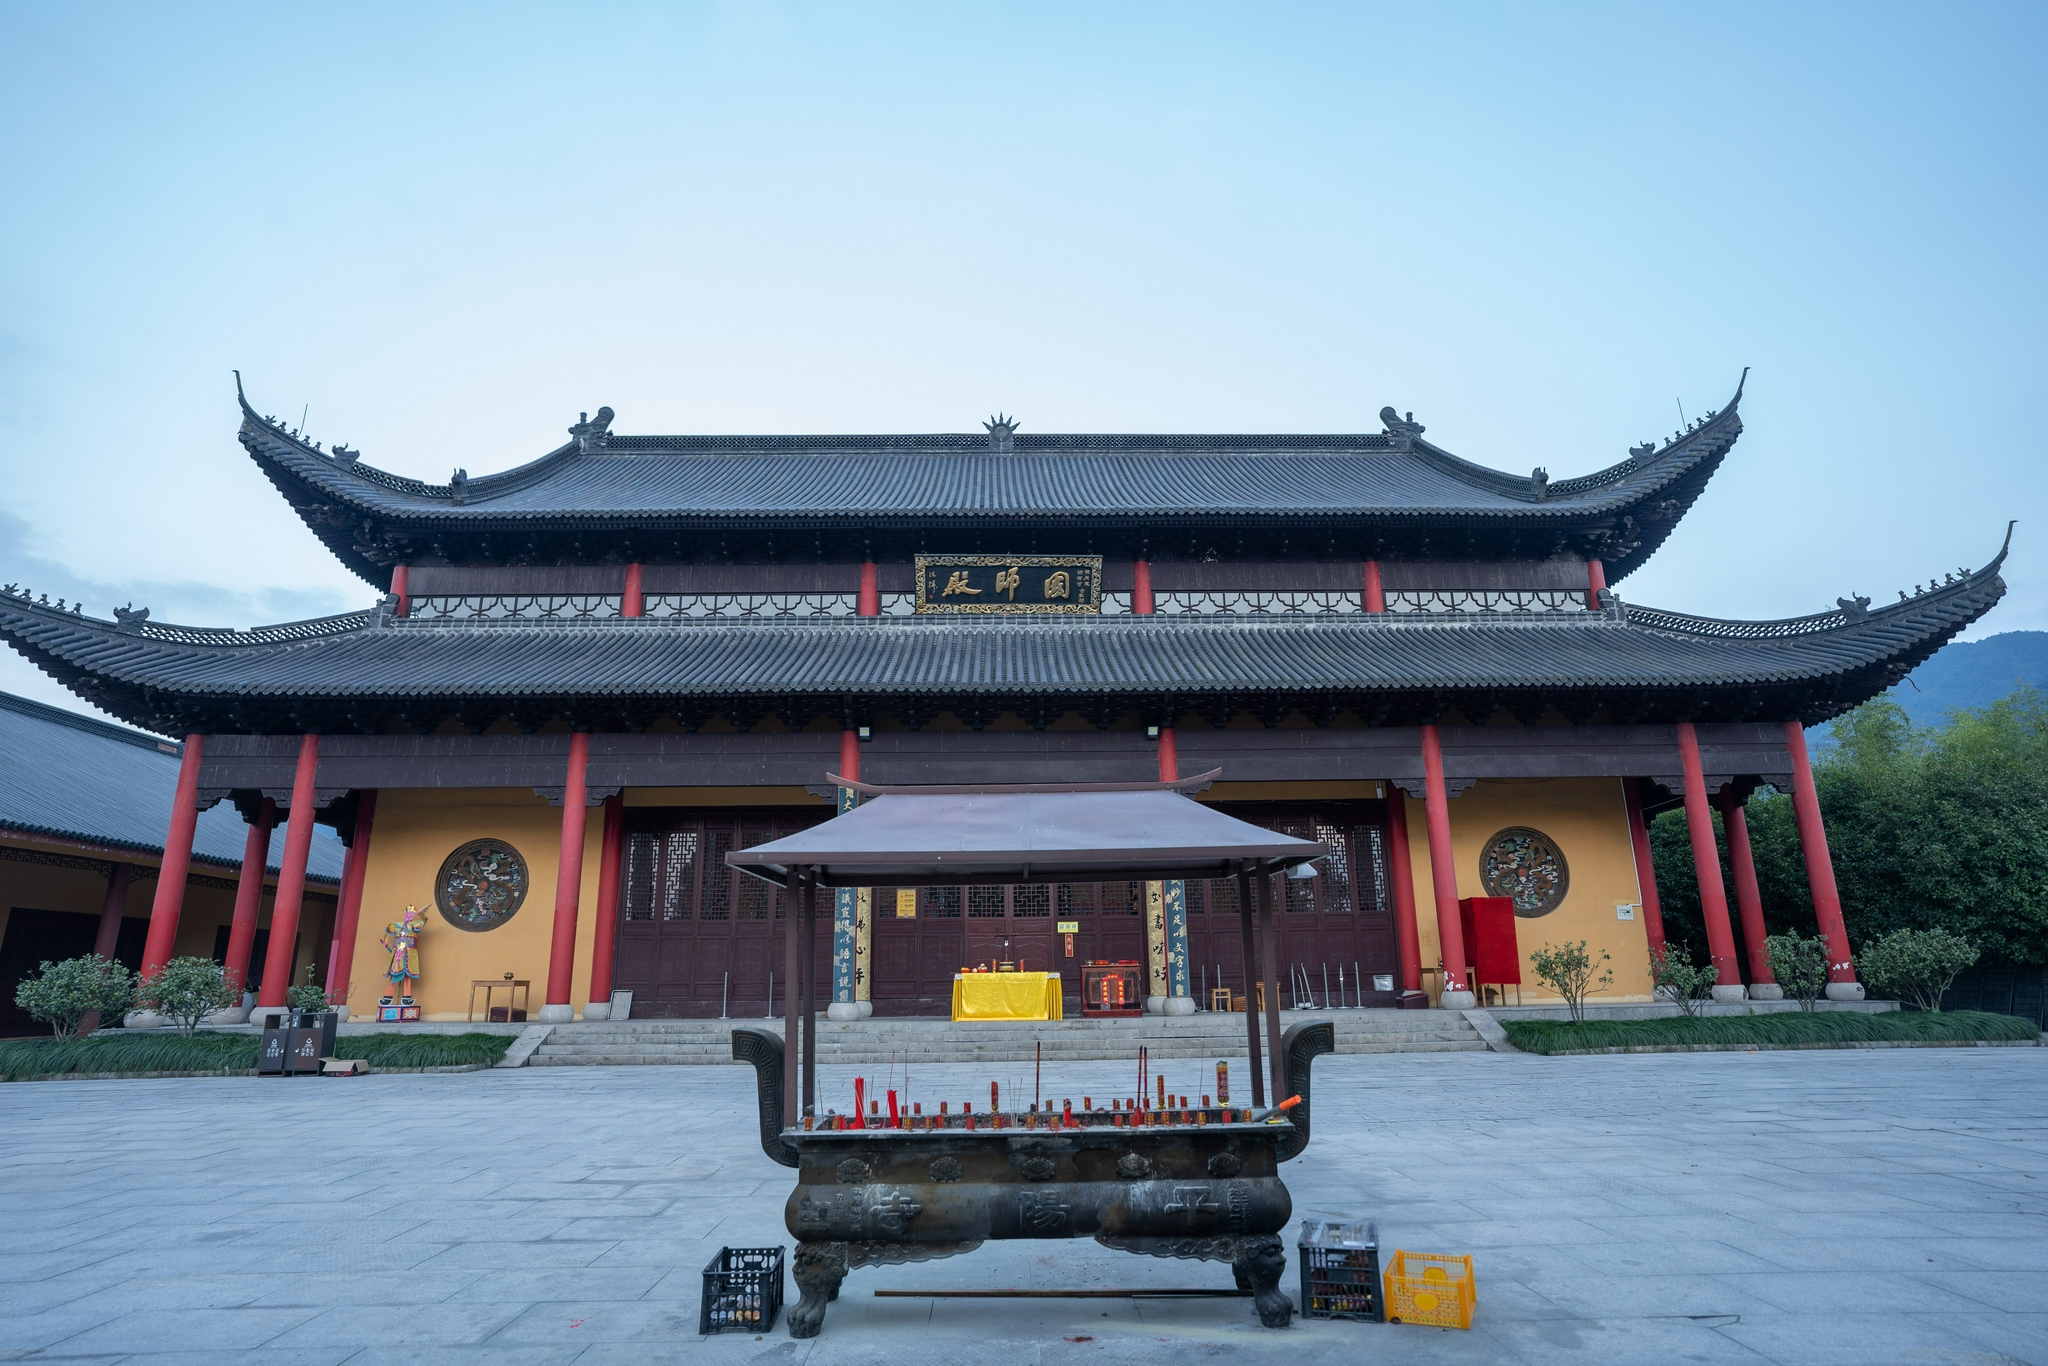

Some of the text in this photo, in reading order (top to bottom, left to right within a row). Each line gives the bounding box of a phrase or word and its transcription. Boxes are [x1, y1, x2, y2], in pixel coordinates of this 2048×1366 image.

[838, 887, 851, 987] 議豈得以語言說
